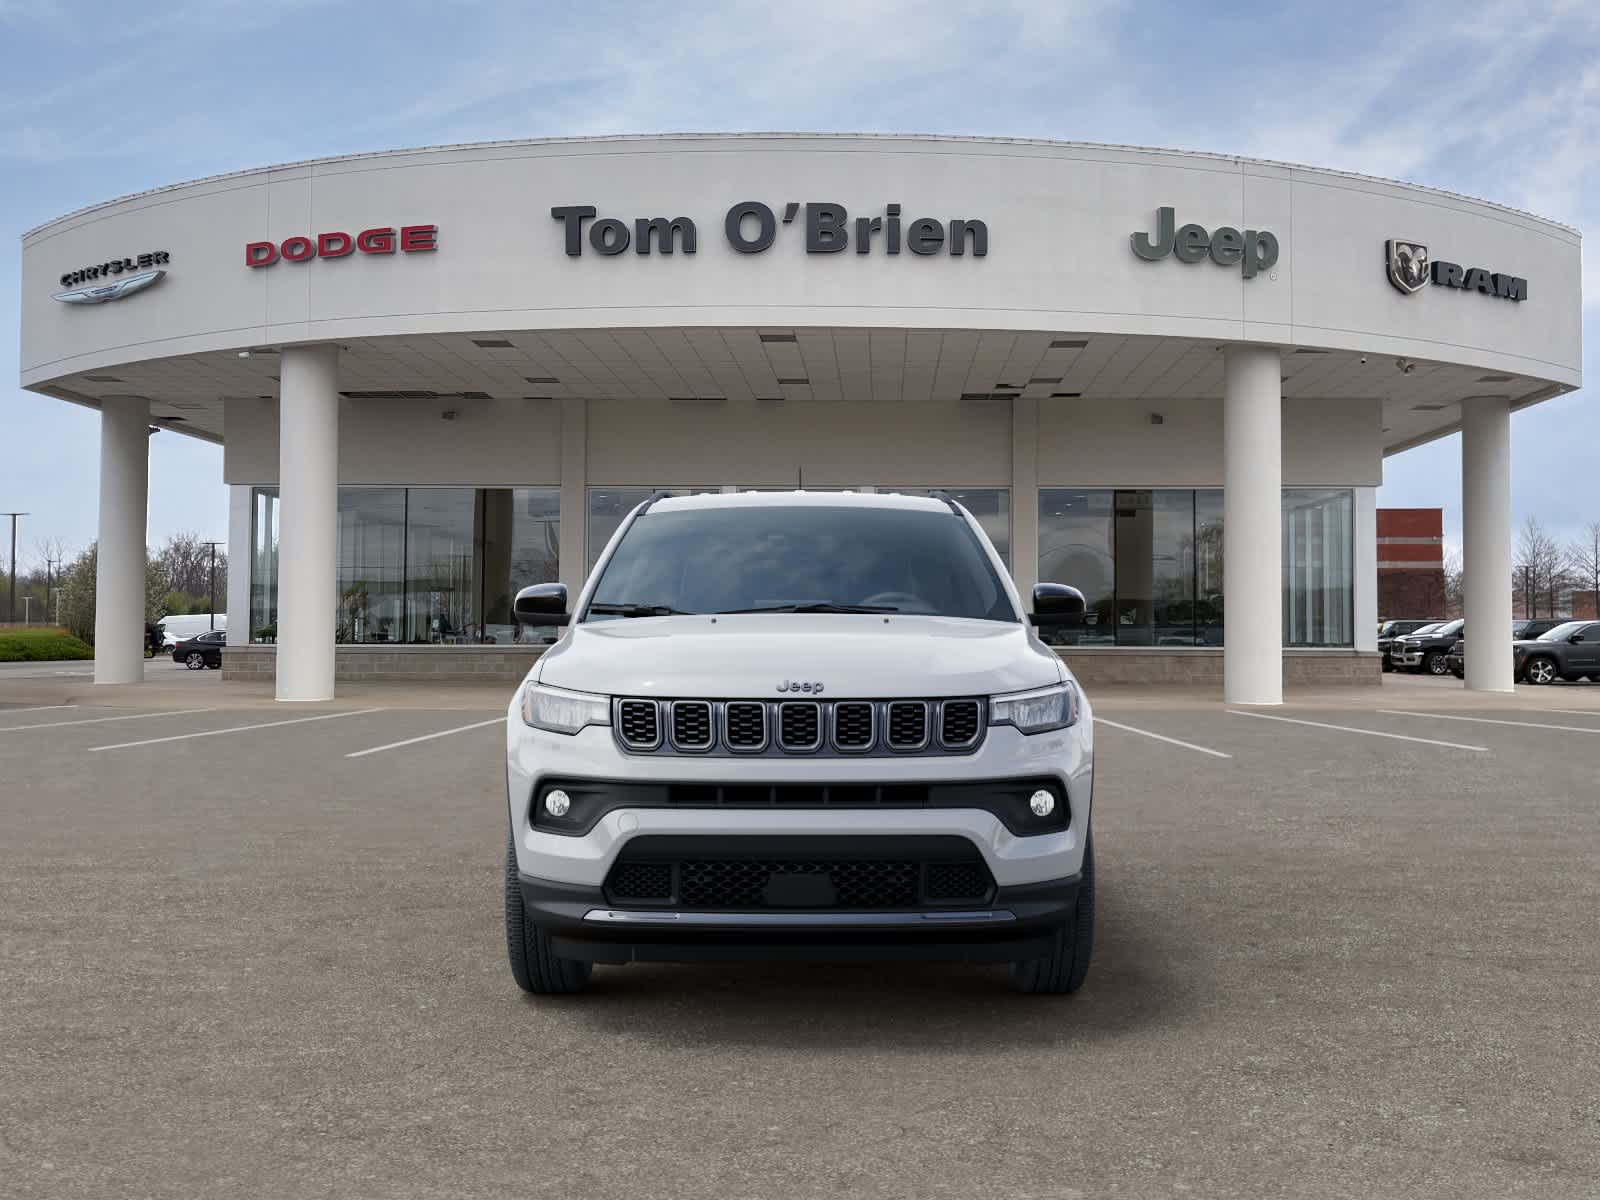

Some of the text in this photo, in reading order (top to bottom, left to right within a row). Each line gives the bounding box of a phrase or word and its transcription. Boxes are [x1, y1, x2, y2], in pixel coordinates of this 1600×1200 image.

[245, 224, 438, 268] DODGE
[550, 201, 989, 257] Tom O'Brien
[1130, 206, 1279, 279] Jeep
[60, 250, 170, 287] CHRYSLER
[1431, 260, 1527, 301] RAM
[776, 680, 824, 695] Jeep
